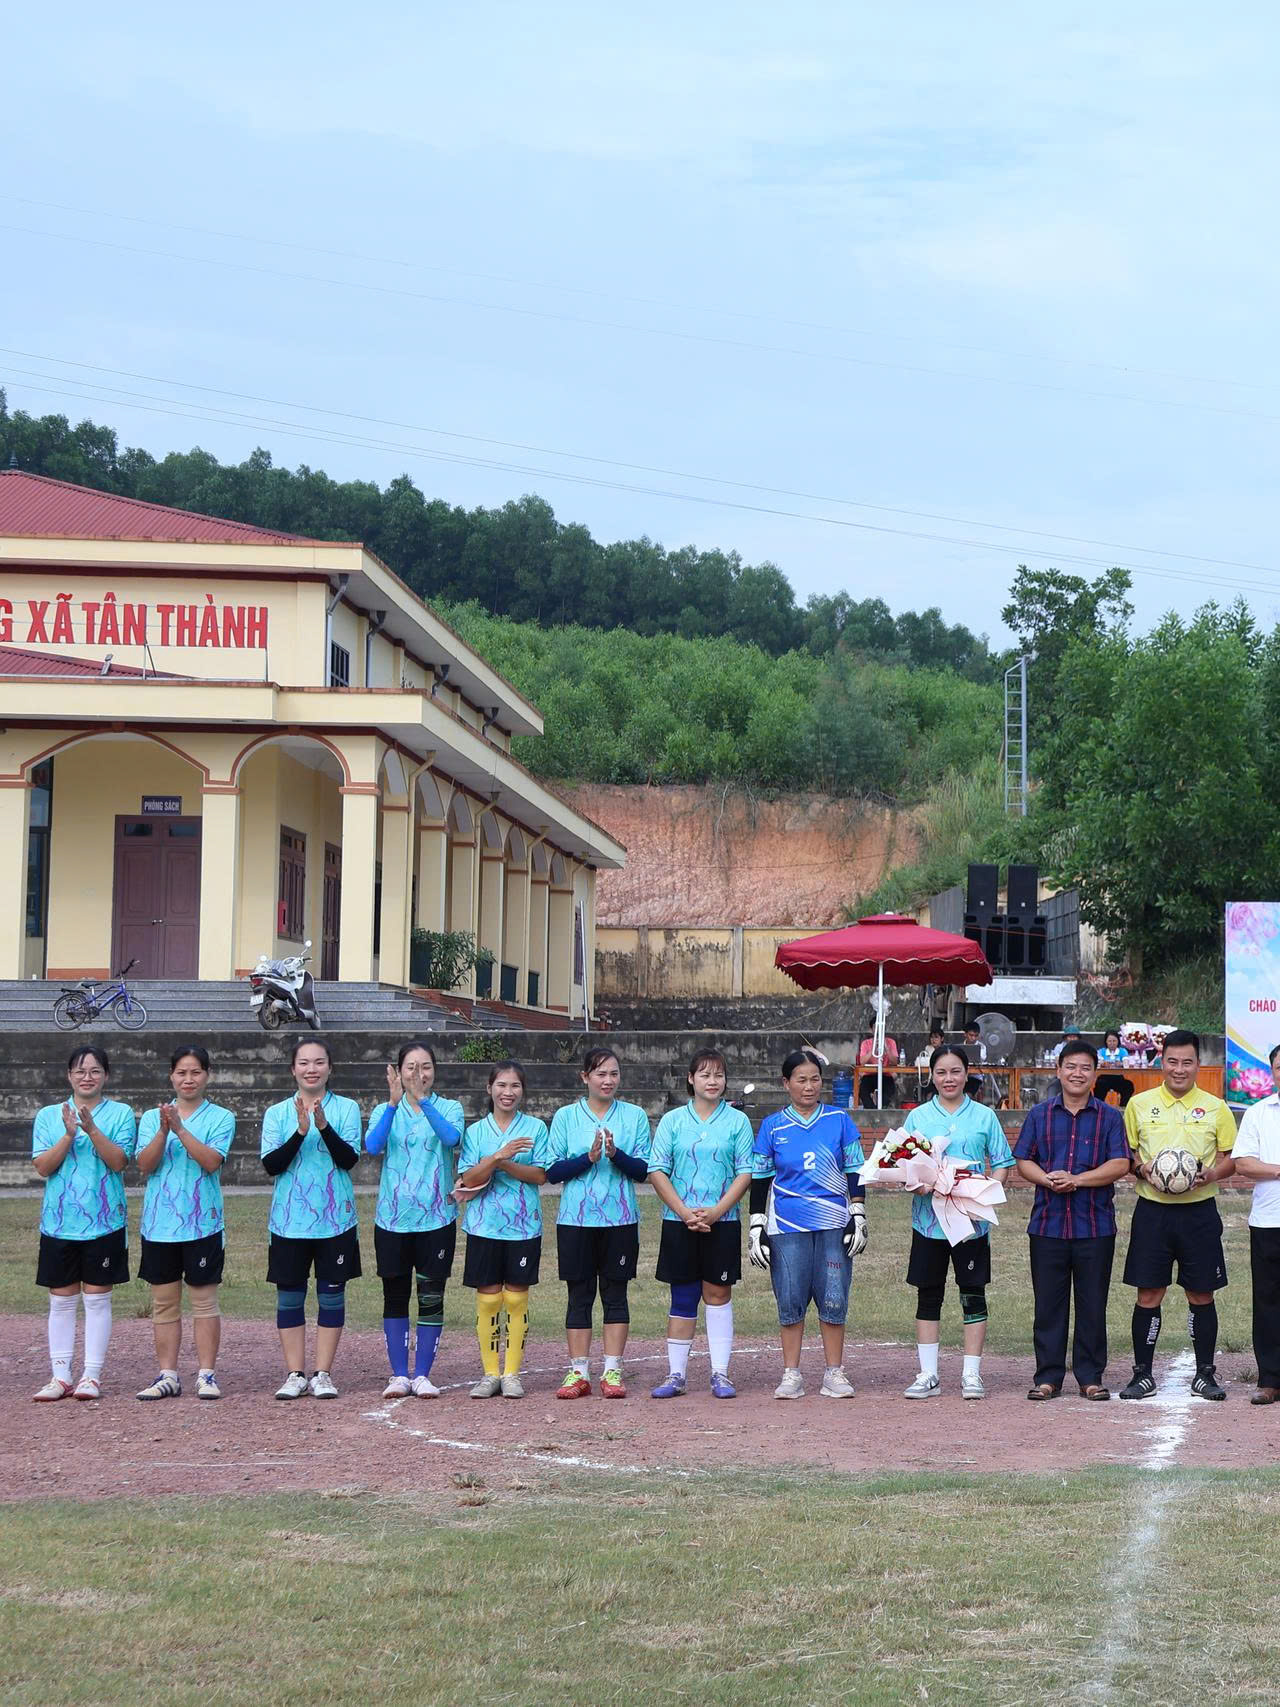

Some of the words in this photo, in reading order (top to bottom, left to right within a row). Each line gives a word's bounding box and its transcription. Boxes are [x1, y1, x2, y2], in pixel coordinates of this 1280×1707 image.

[26, 593, 75, 644] XÃ
[82, 592, 147, 645] TÂN
[157, 594, 268, 648] THÀNH
[144, 800, 163, 811] PHÒNG
[164, 799, 180, 811] SÁCH
[1249, 997, 1276, 1012] CHÀO
[803, 1152, 816, 1170] 2
